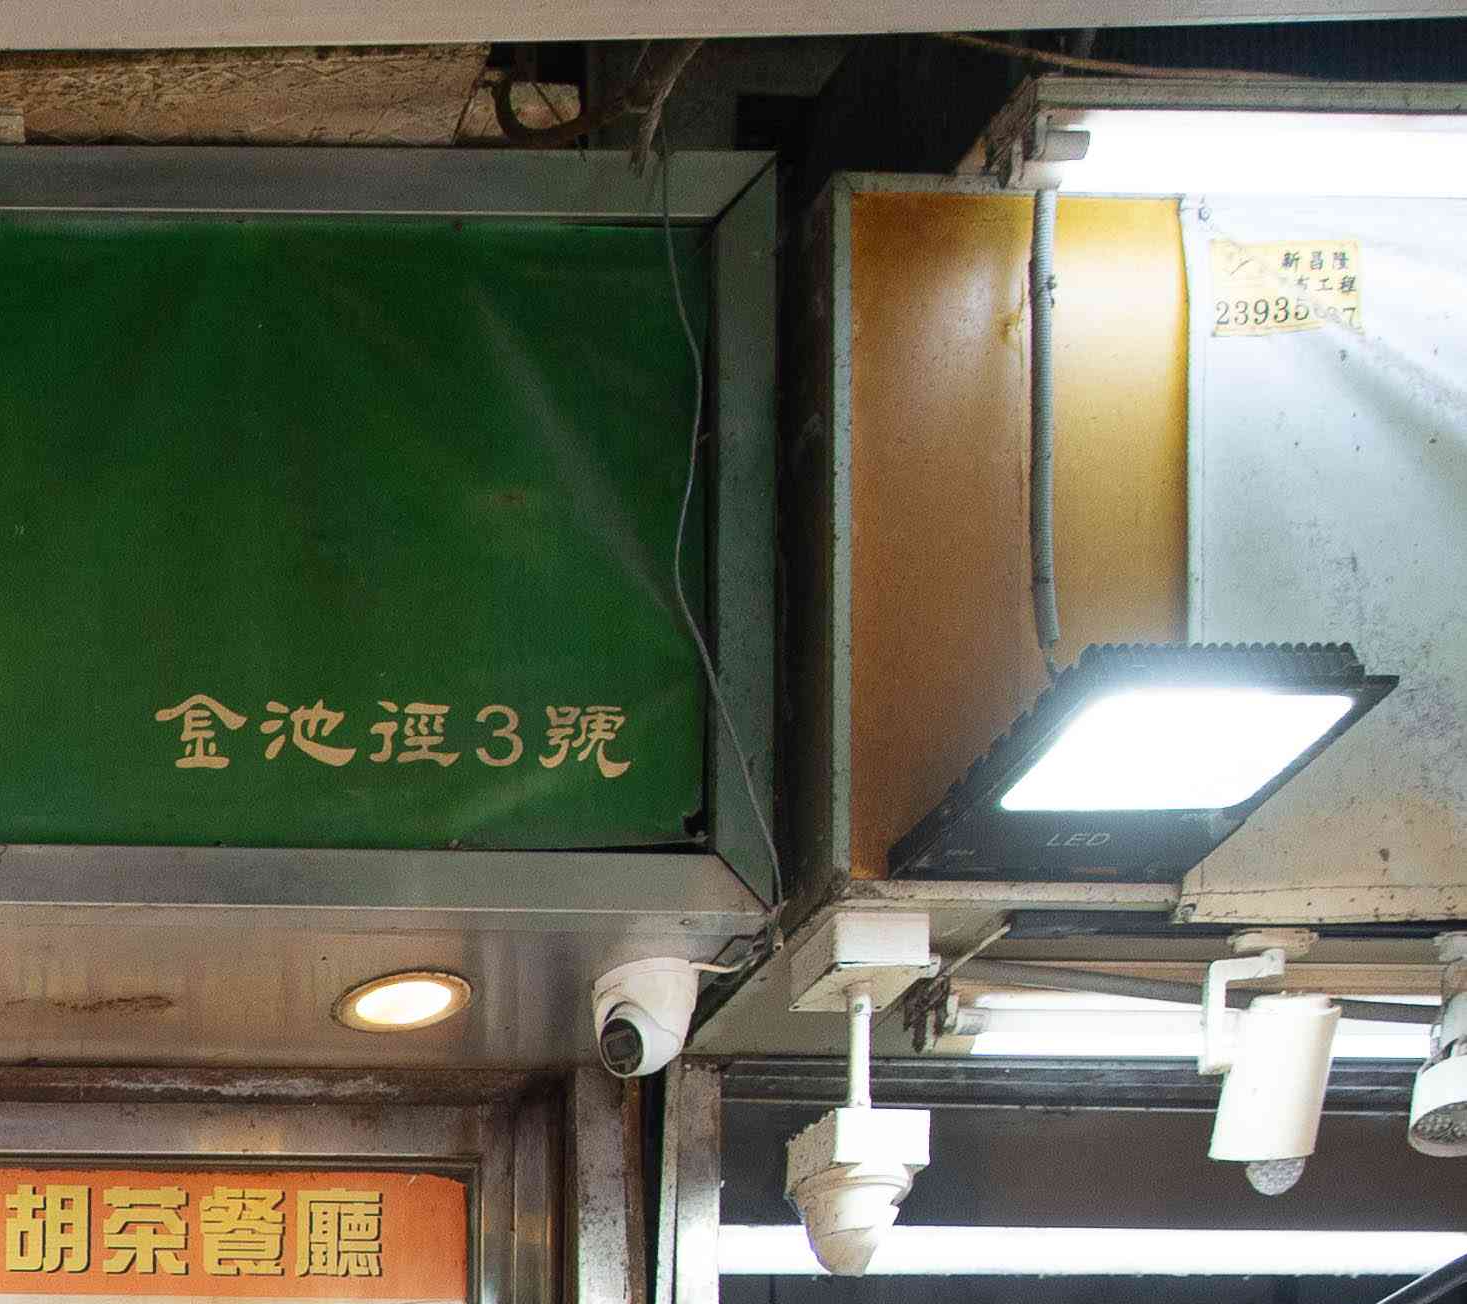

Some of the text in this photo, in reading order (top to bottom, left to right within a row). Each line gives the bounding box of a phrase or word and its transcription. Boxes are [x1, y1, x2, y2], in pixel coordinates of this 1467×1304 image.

[155, 692, 632, 778] 金池徑3號
[1046, 832, 1111, 847] LED
